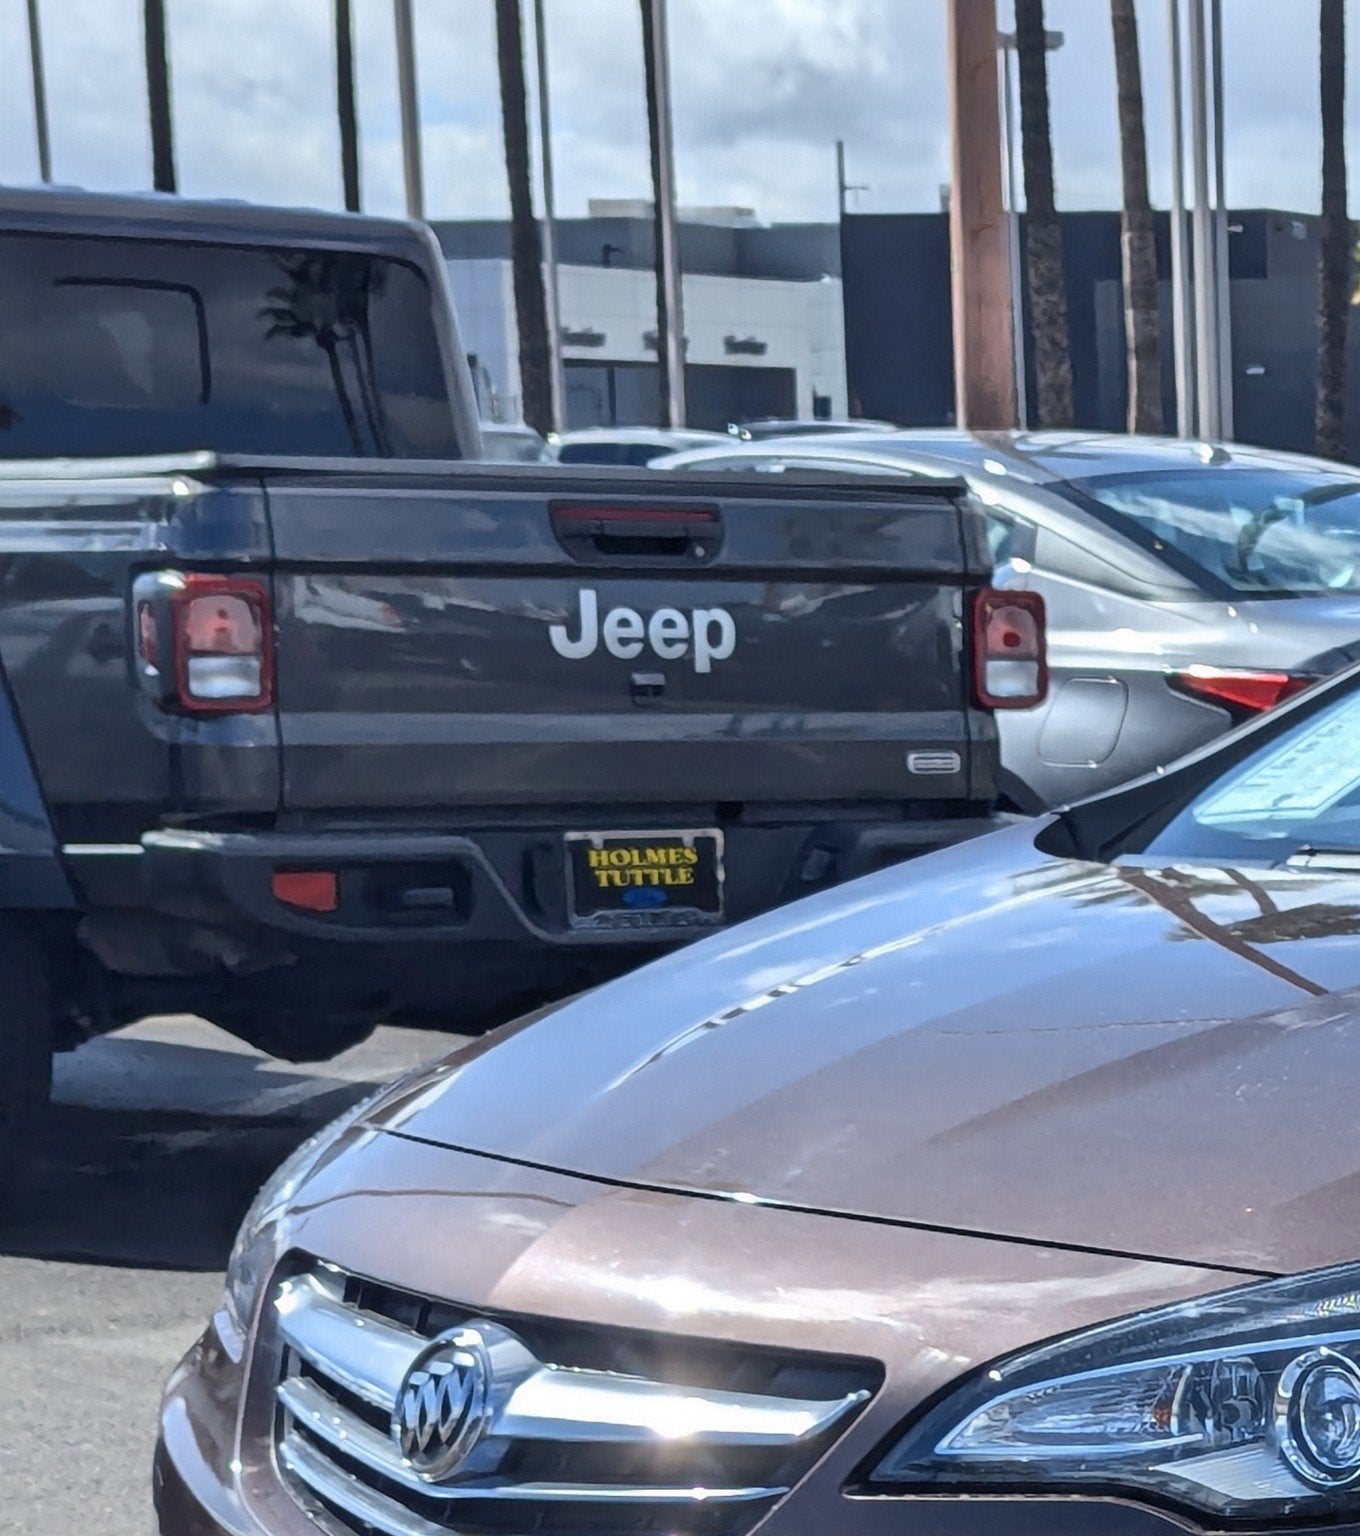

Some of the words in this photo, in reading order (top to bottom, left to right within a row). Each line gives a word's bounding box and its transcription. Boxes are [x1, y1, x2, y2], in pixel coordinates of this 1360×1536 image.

[549, 589, 736, 674] Jeep
[588, 847, 699, 867] HOLMES
[595, 867, 695, 887] TUTTLE
